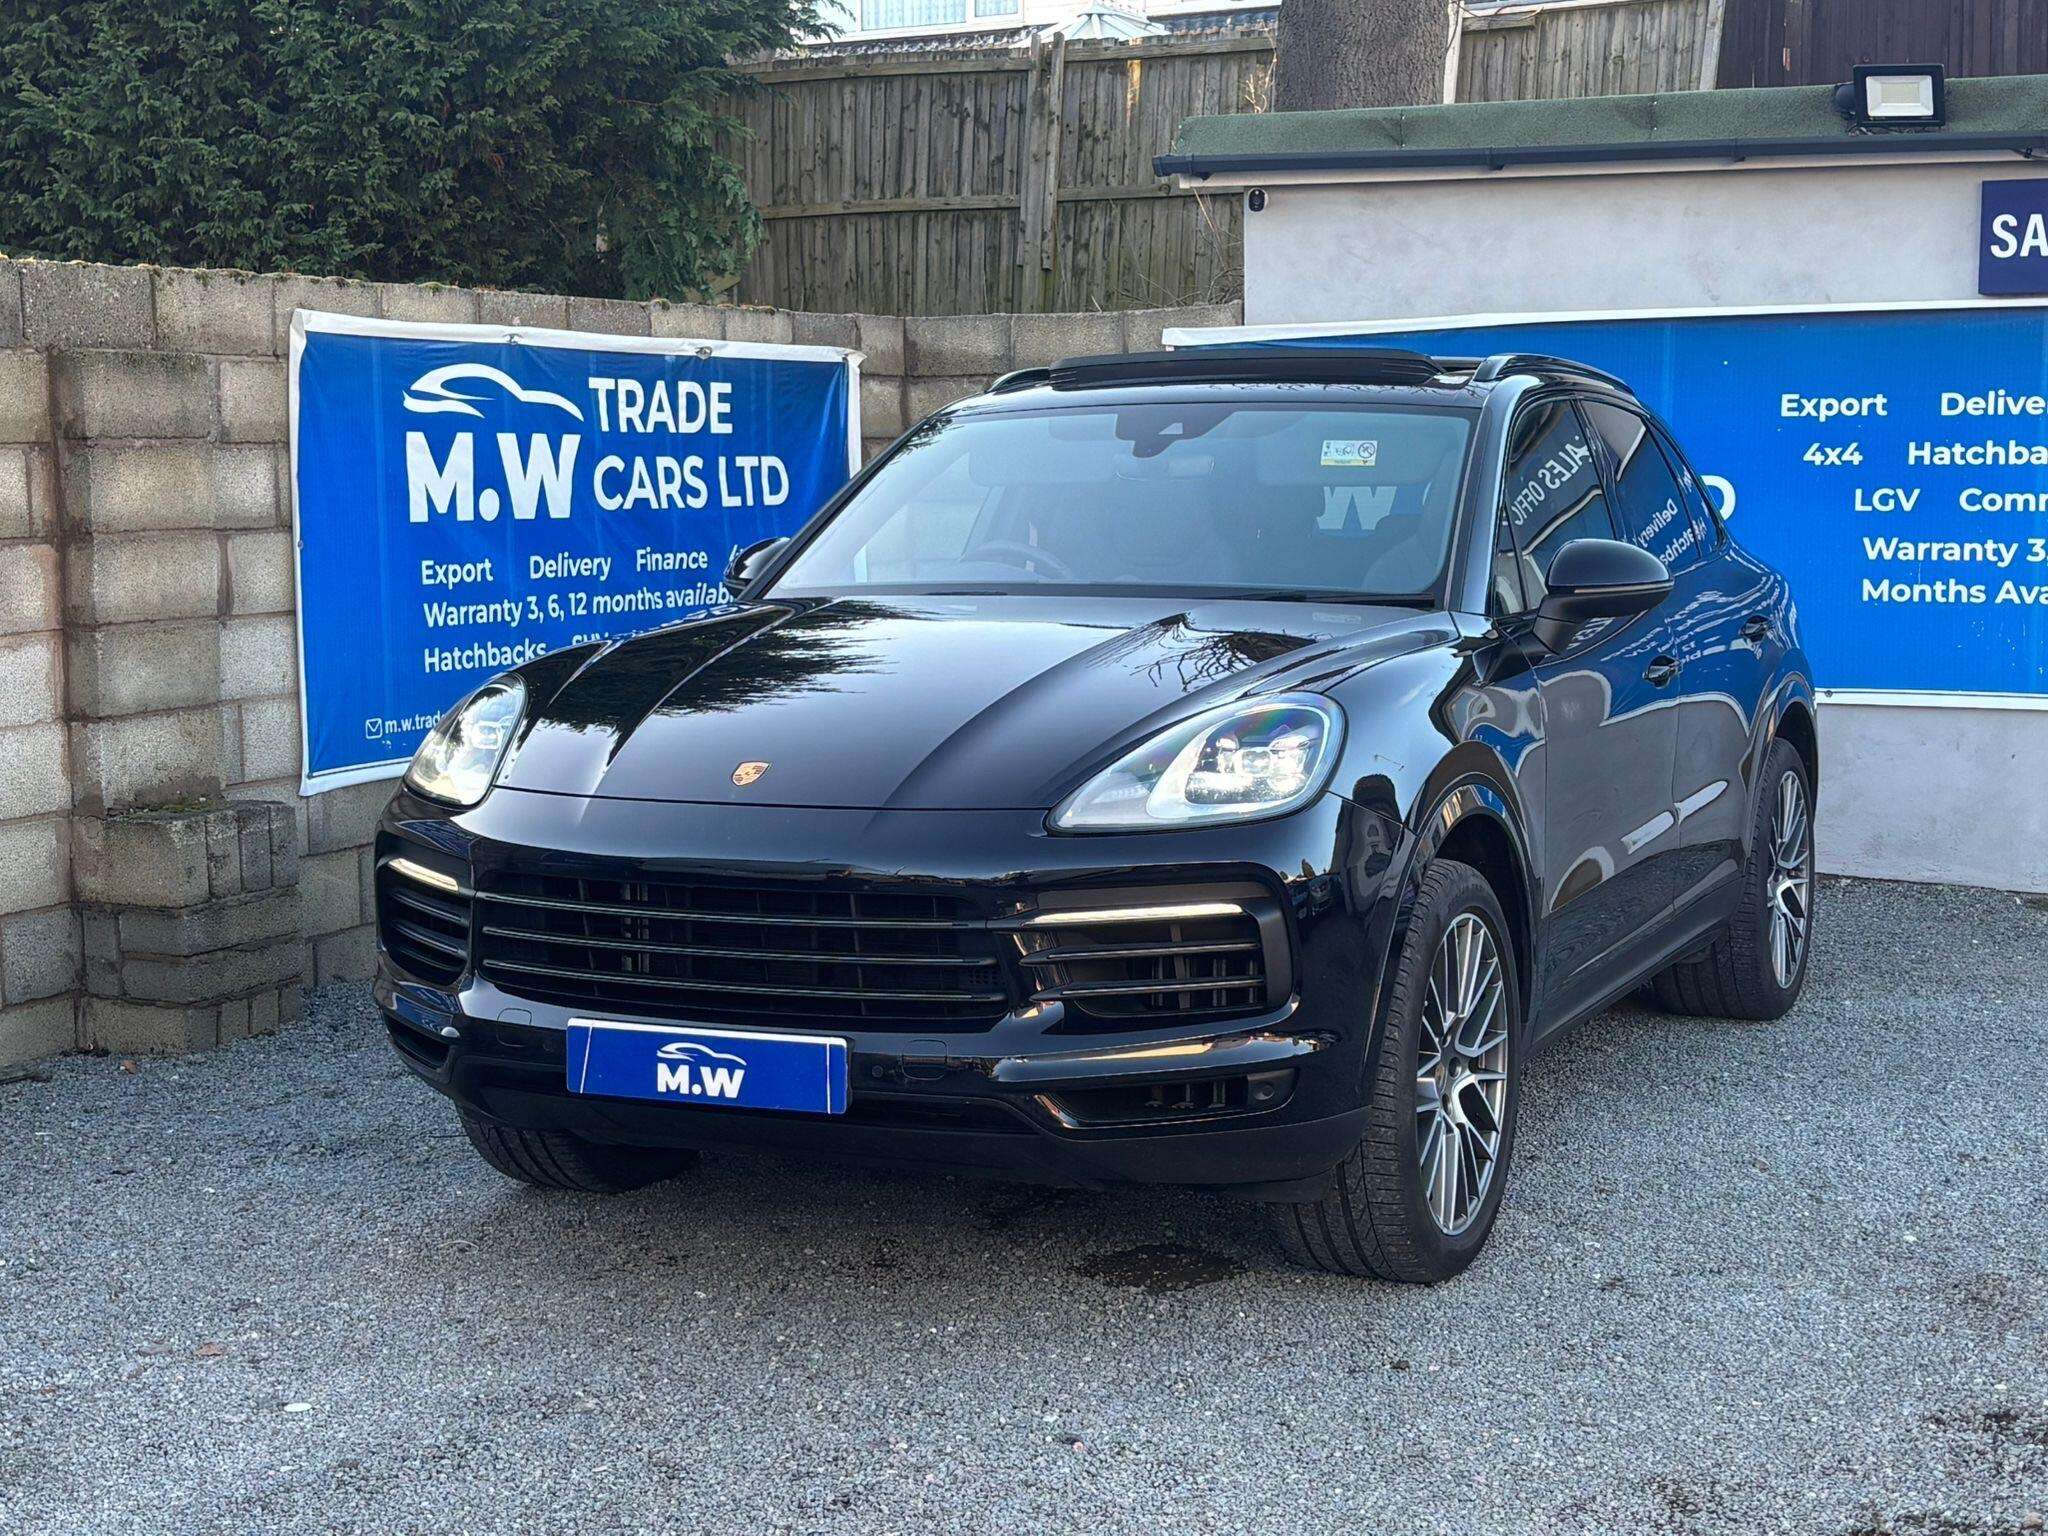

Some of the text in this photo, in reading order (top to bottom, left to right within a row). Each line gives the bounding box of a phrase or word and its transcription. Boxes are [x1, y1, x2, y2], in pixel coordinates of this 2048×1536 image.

[1990, 213, 2048, 259] SA
[588, 376, 733, 434] TRADE
[1781, 389, 2048, 422] Export Delive
[1803, 439, 2048, 466] 4x4 Hatchba
[405, 431, 581, 523] M.W
[593, 455, 789, 511] CARS LTD
[1855, 488, 1921, 512] LGV
[421, 558, 494, 590] Export
[530, 551, 611, 581] Delivery
[636, 547, 708, 572] Finance
[1863, 537, 2019, 567] Warranty
[423, 582, 733, 628] Warranty 3, 6, 12 months availab
[1862, 578, 1987, 603] Months
[424, 638, 547, 673] Hatchbacks
[385, 710, 444, 734] m.w.trad
[657, 1062, 746, 1099] M.W
